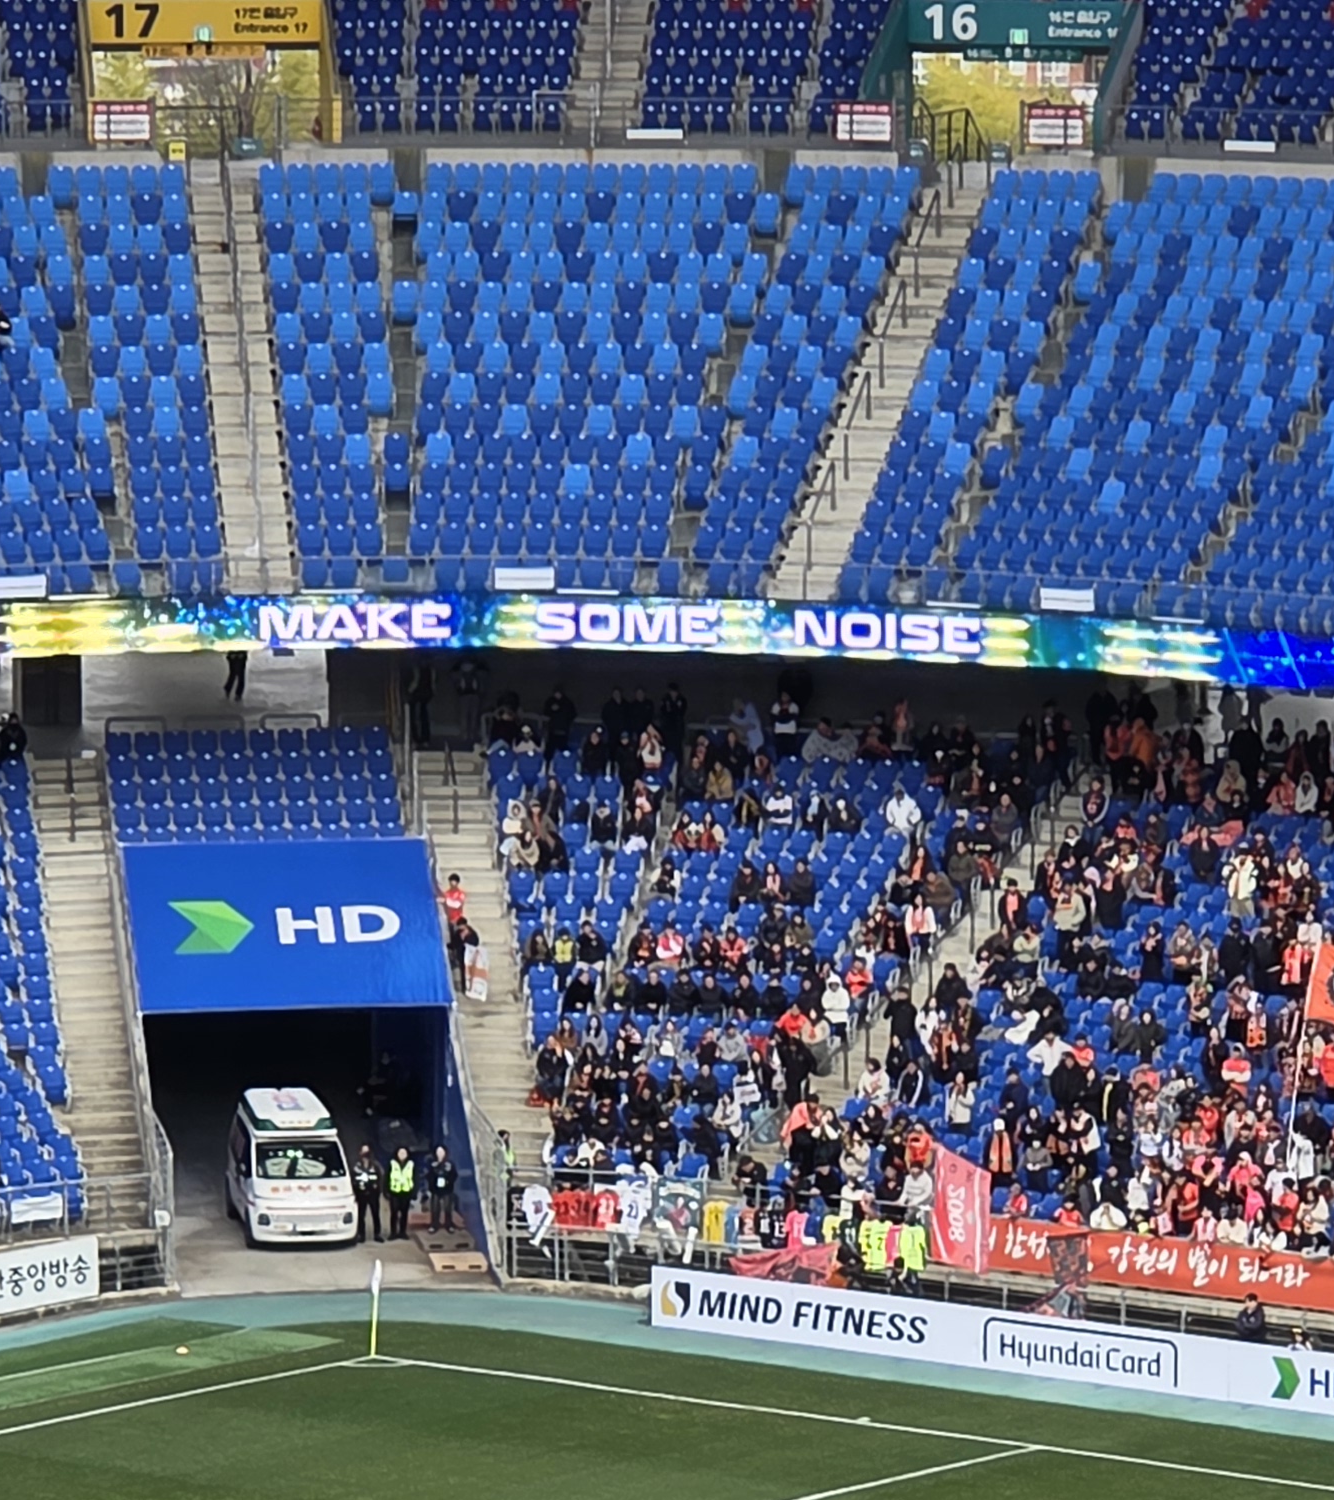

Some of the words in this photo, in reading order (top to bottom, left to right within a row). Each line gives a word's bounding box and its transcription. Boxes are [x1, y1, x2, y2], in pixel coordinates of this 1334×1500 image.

[105, 3, 159, 38] 17
[234, 22, 289, 34] Entrance
[294, 22, 308, 34] 17
[925, 4, 977, 41] 16
[1048, 25, 1102, 38] Entrance
[259, 602, 452, 640] MAKE
[535, 602, 719, 644] SOME
[794, 610, 981, 654] NOISE
[276, 905, 401, 945] HD
[946, 1183, 966, 1244] 2008
[1108, 1235, 1178, 1276] 강원의
[1187, 1242, 1228, 1288] 별이
[1238, 1256, 1311, 1288] 되어라
[698, 1289, 783, 1325] MIND
[792, 1300, 929, 1344] FITNESS
